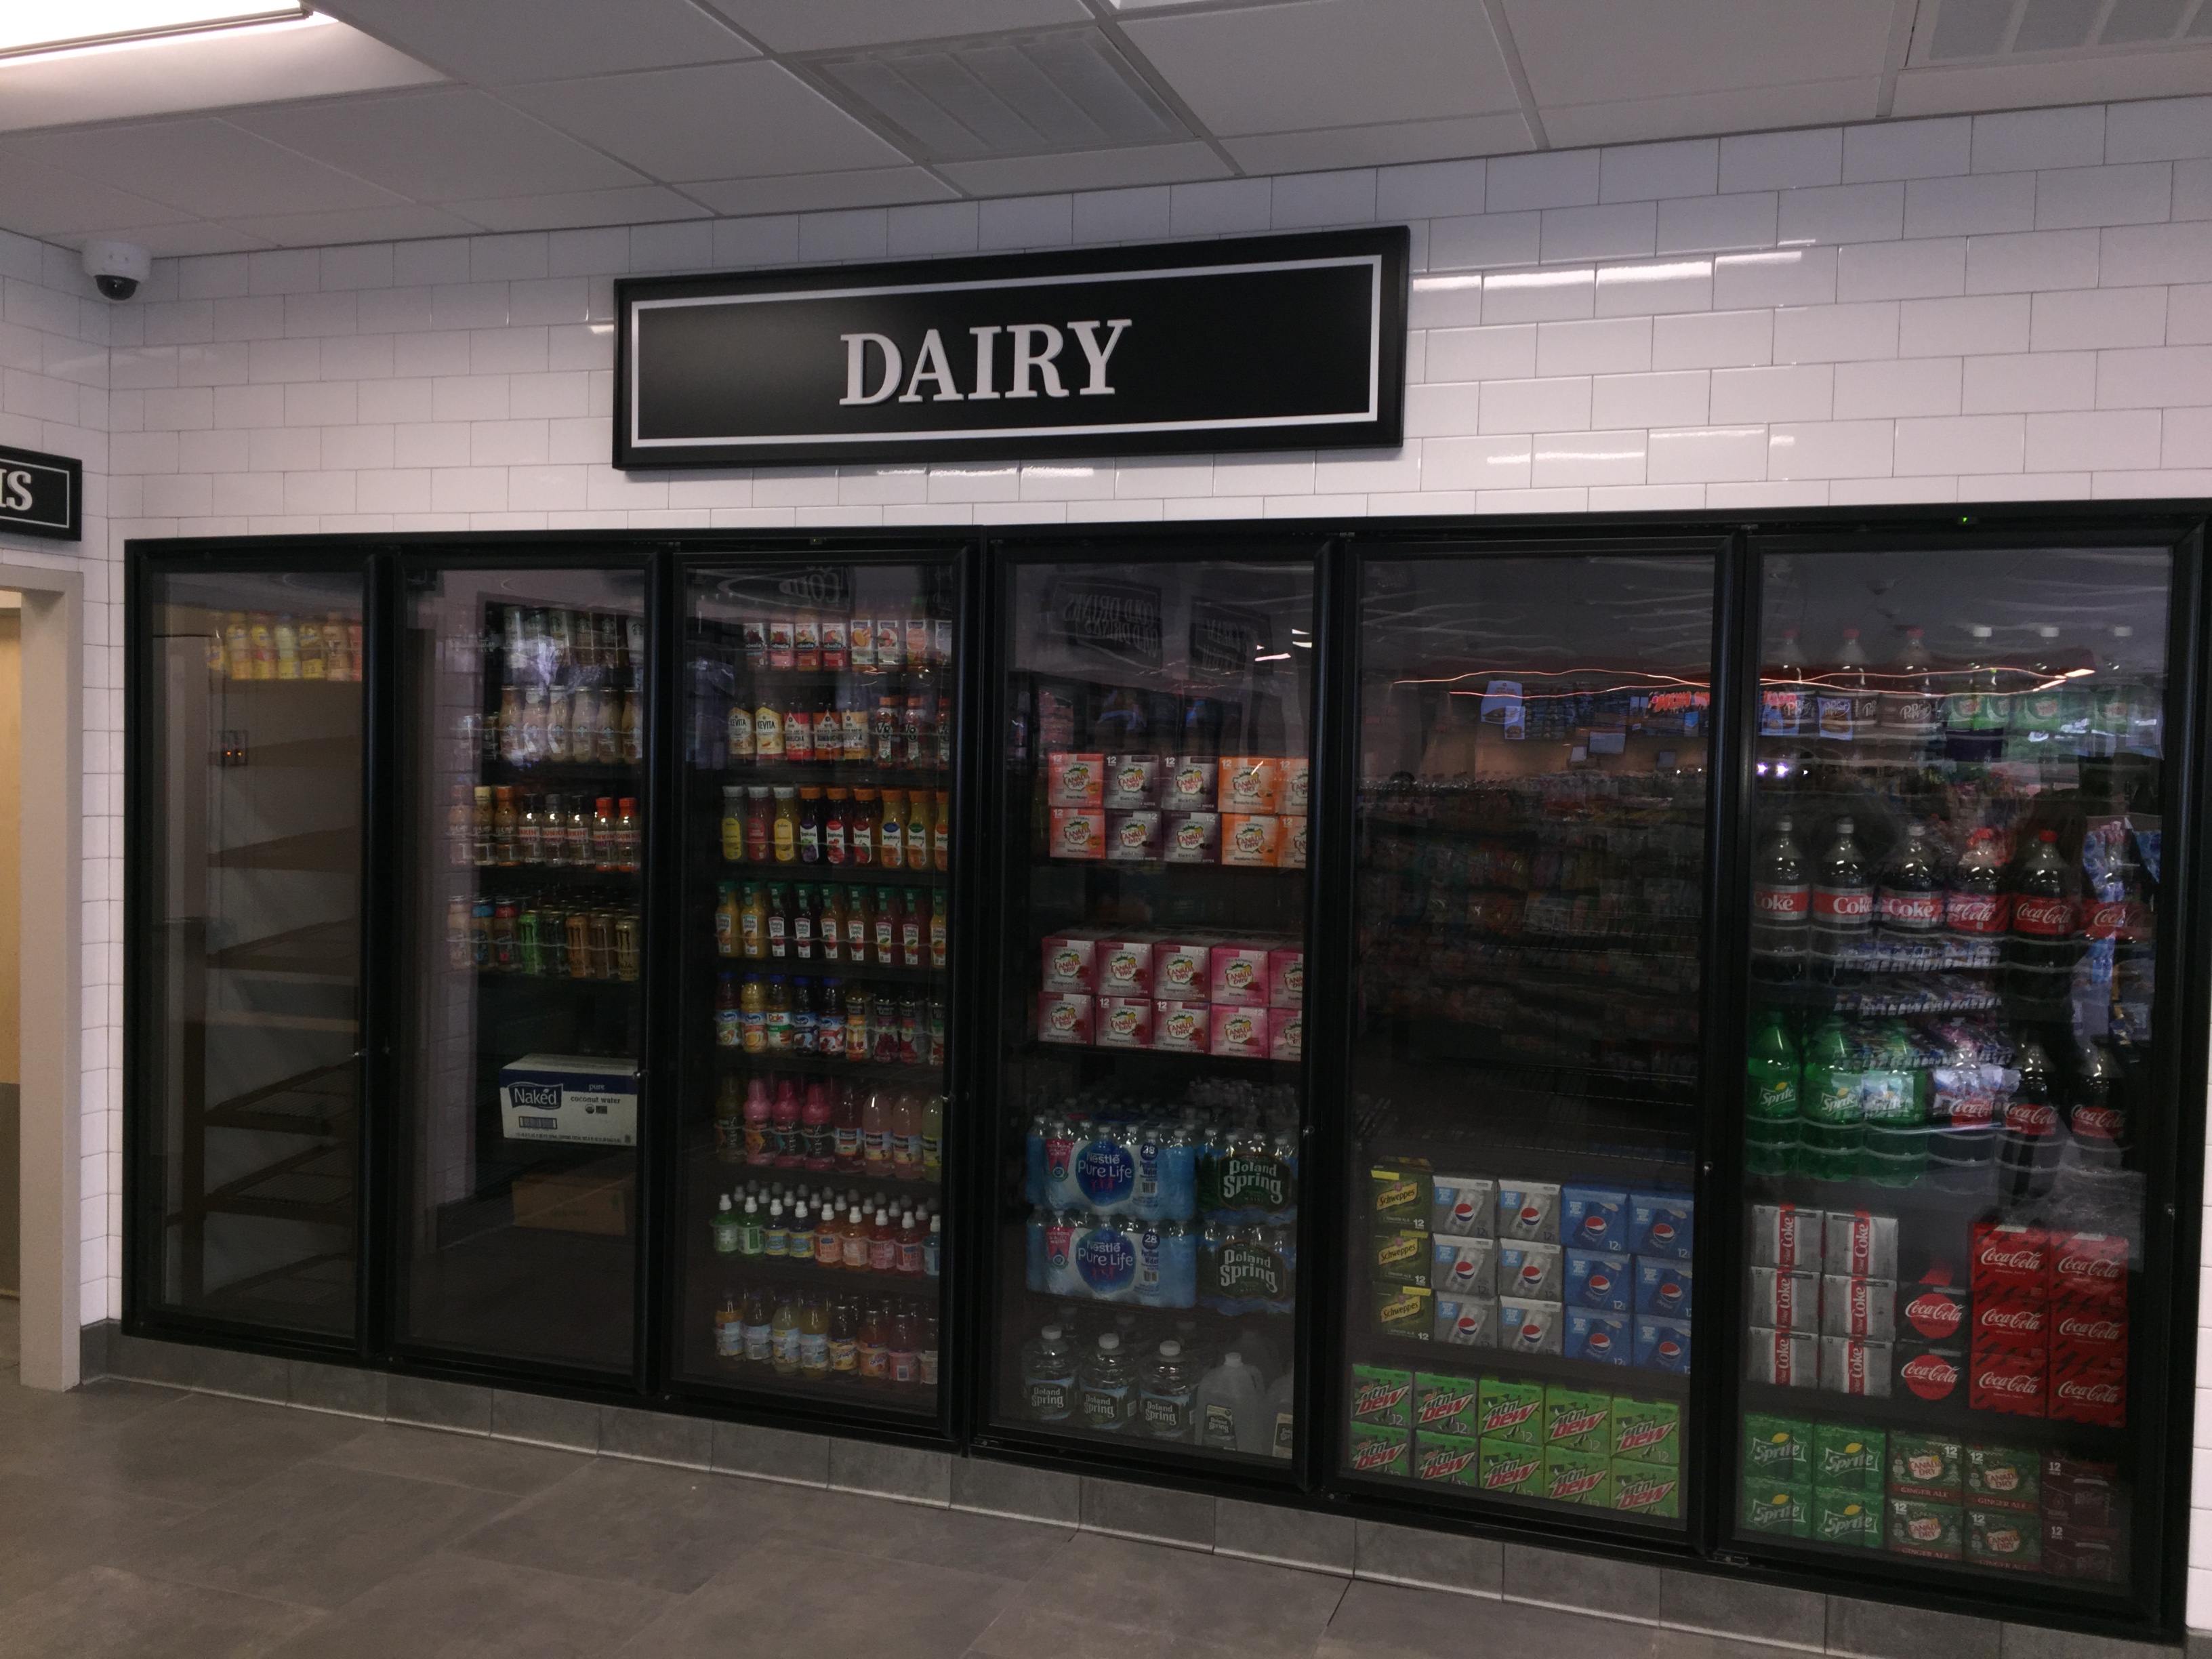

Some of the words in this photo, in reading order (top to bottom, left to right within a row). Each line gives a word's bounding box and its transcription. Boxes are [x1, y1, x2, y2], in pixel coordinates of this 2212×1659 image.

[839, 319, 1132, 405] DAIRY
[1753, 891, 1795, 911] Coke
[1833, 897, 1872, 914] Coke
[1889, 899, 1934, 918] Coke
[2016, 902, 2072, 924] Coca-Cola
[514, 1088, 557, 1105] Naked
[1762, 1082, 1795, 1106] Sprite
[2006, 1102, 2058, 1124] Coca-Cola
[2071, 1105, 2125, 1128] Coca-Cola
[1086, 1153, 1120, 1164] Nestlé
[1142, 1146, 1155, 1155] 28
[1078, 1160, 1106, 1178] Pure
[1109, 1166, 1132, 1183] Life
[1229, 1160, 1277, 1177] Poland
[1223, 1173, 1283, 1204] Spring
[1380, 1188, 1415, 1206] Schweppes
[1413, 1218, 1425, 1229] 12
[1145, 1234, 1158, 1243] 28
[1781, 1216, 1794, 1248] Coke
[1087, 1241, 1120, 1252] Nestlé
[1609, 1241, 1618, 1250] 12
[1854, 1224, 1869, 1258] Coke
[1078, 1248, 1107, 1266] Pure
[1111, 1252, 1133, 1271] Life
[1224, 1250, 1271, 1268] Poland
[1380, 1243, 1416, 1261] Schweppes
[1678, 1248, 1687, 1258] 12
[1980, 1248, 2043, 1270] Coca-Cola
[2058, 1256, 2123, 1278] Coca-Cola
[1220, 1263, 1278, 1293] Spring
[1415, 1275, 1425, 1284] 12
[1777, 1278, 1790, 1309] Coke
[1383, 1302, 1418, 1319] Schweppes
[1614, 1300, 1622, 1310] 12
[1852, 1286, 1866, 1319] Coke
[1905, 1300, 1964, 1322] Coca-Cola
[1982, 1308, 2043, 1331] Coca-Cola
[1418, 1332, 1429, 1340] 12
[2060, 1318, 2123, 1340] Coca-Cola
[1777, 1338, 1790, 1369] Coke
[1849, 1347, 1862, 1378] Coke
[1901, 1361, 1961, 1383] Coca-Cola
[1979, 1371, 2041, 1393] Coca-Cola
[1033, 1387, 1061, 1396] Poland
[2058, 1380, 2122, 1404] Coca-Cola
[1031, 1394, 1064, 1408] Spring
[1085, 1395, 1111, 1406] Poland
[1147, 1401, 1173, 1413] Poland
[1084, 1401, 1115, 1418] Spring
[1145, 1409, 1176, 1425] Spring
[1208, 1422, 1229, 1433] Spring
[1392, 1414, 1403, 1425] 12
[1456, 1422, 1466, 1434] 12
[1521, 1431, 1532, 1442] 12
[1589, 1440, 1600, 1451] 12
[1754, 1442, 1799, 1462] Sprite
[1945, 1446, 1957, 1455] 12
[1826, 1452, 1873, 1473] Sprite
[1971, 1452, 1983, 1461] 12
[1909, 1462, 1942, 1471] CANADA
[2049, 1462, 2061, 1471] 12
[1984, 1473, 2019, 1484] CANADA
[1996, 1480, 2012, 1488] DRY
[1901, 1487, 1931, 1496] GINGER
[1894, 1502, 1907, 1512] 12
[1978, 1497, 2010, 1506] GINGER
[1754, 1504, 1799, 1523] Sprite
[1972, 1513, 1985, 1523] 12
[1825, 1515, 1872, 1534] Sprite
[1908, 1524, 1941, 1534] CANADA
[2051, 1526, 2063, 1536] 12
[1919, 1530, 1936, 1538] DRY
[1987, 1536, 2020, 1545] CANADA
[1902, 1548, 1933, 1557] GINGER
[1996, 1542, 2014, 1550] DRY
[1980, 1559, 2010, 1568] GINGER
[2011, 1563, 2028, 1571] ALE
